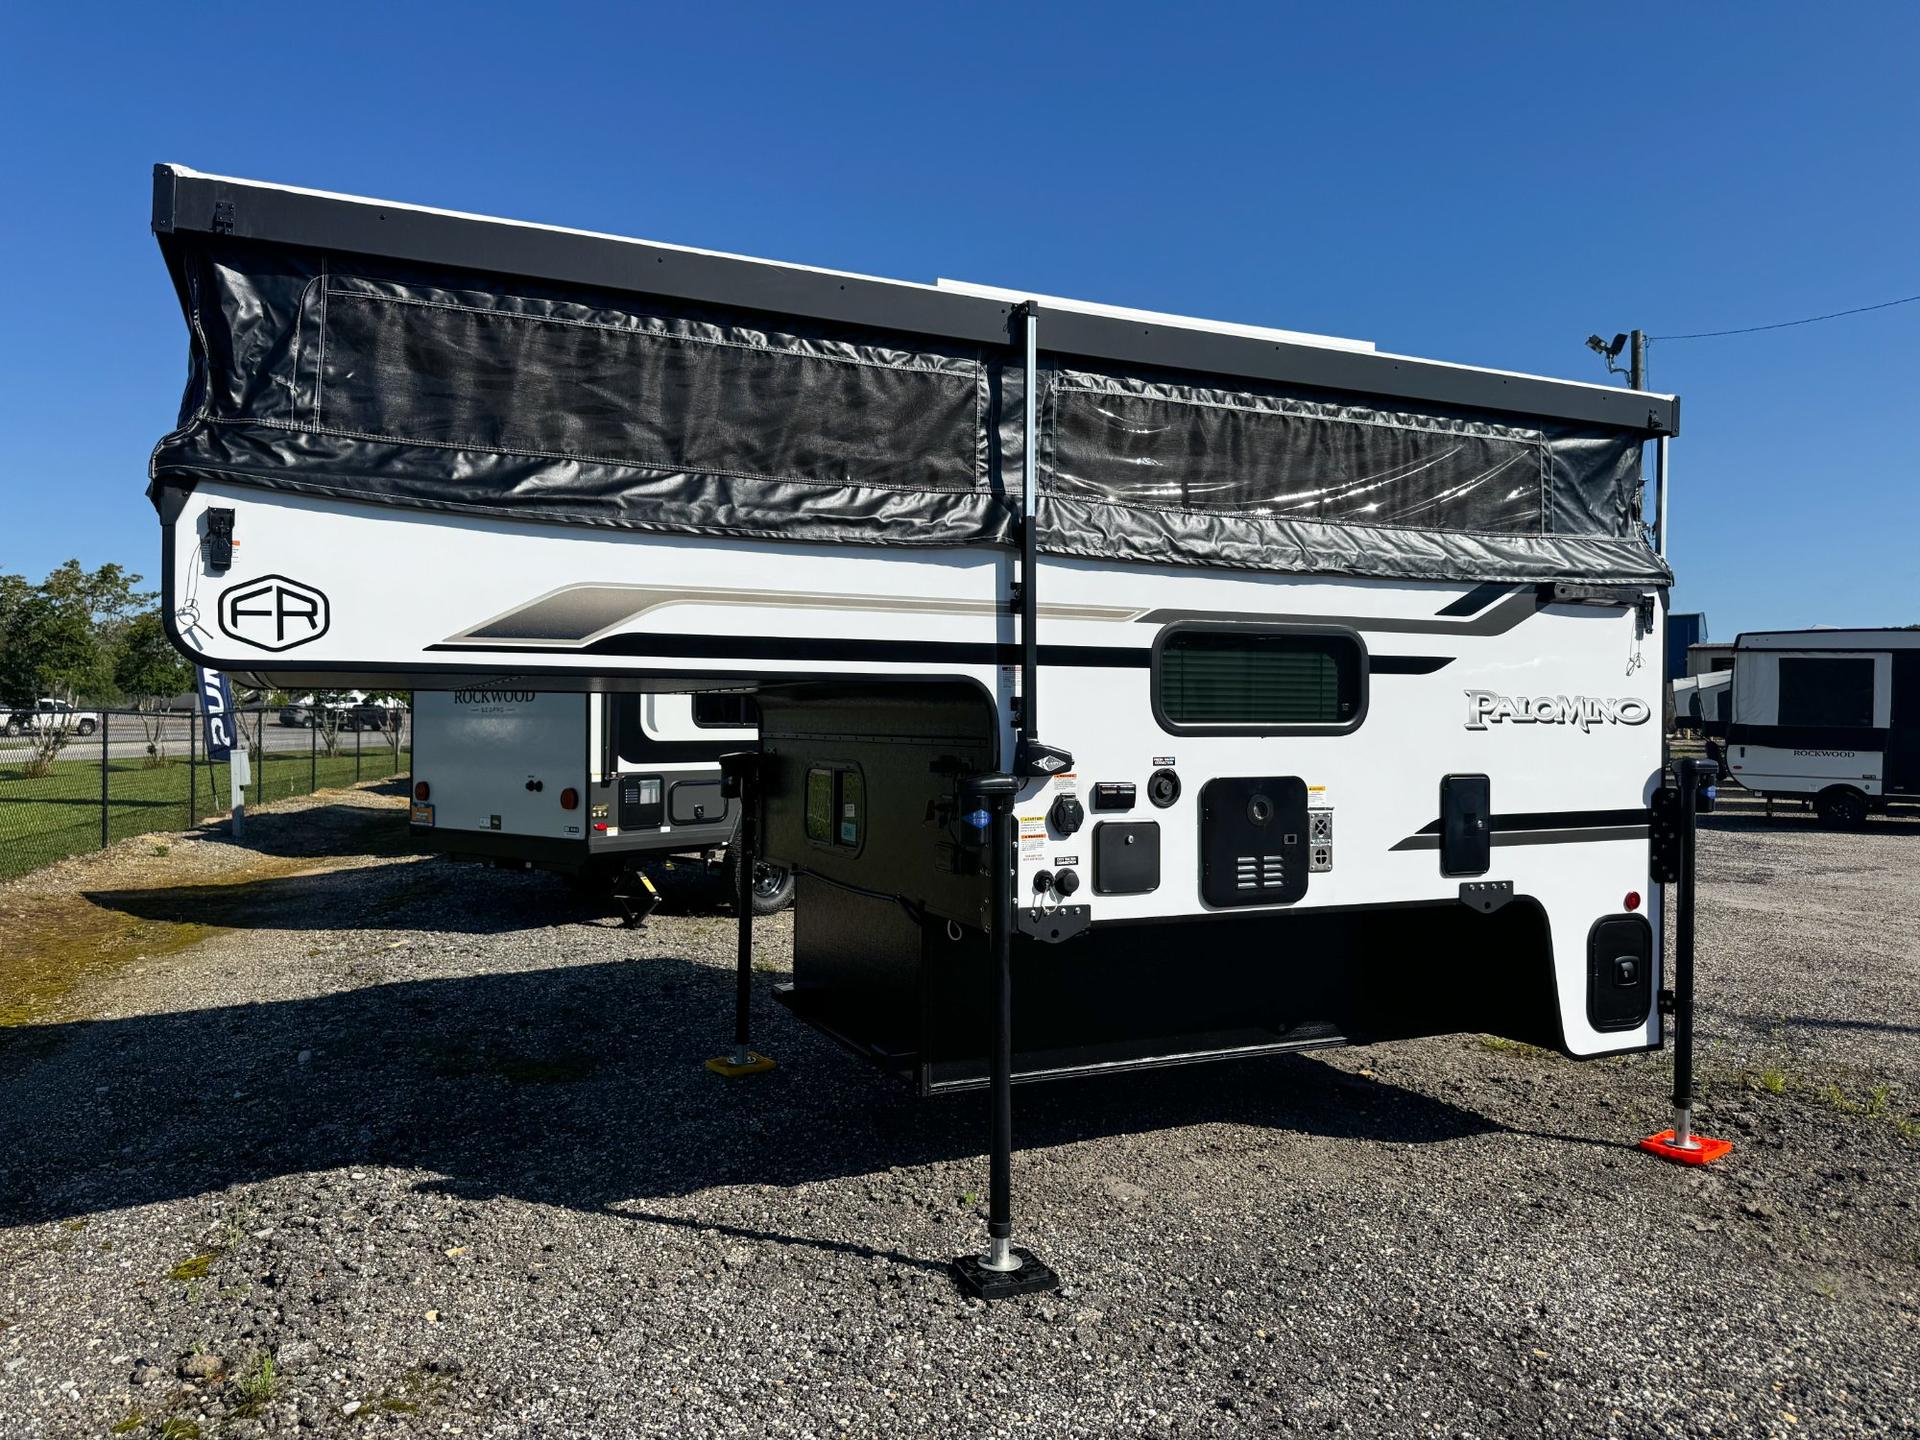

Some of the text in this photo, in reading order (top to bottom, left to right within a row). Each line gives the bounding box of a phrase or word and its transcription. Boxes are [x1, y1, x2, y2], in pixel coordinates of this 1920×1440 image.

[231, 585, 318, 642] FR
[454, 690, 536, 704] ROCKWOOD
[1793, 750, 1855, 758] ROCKWOOD
